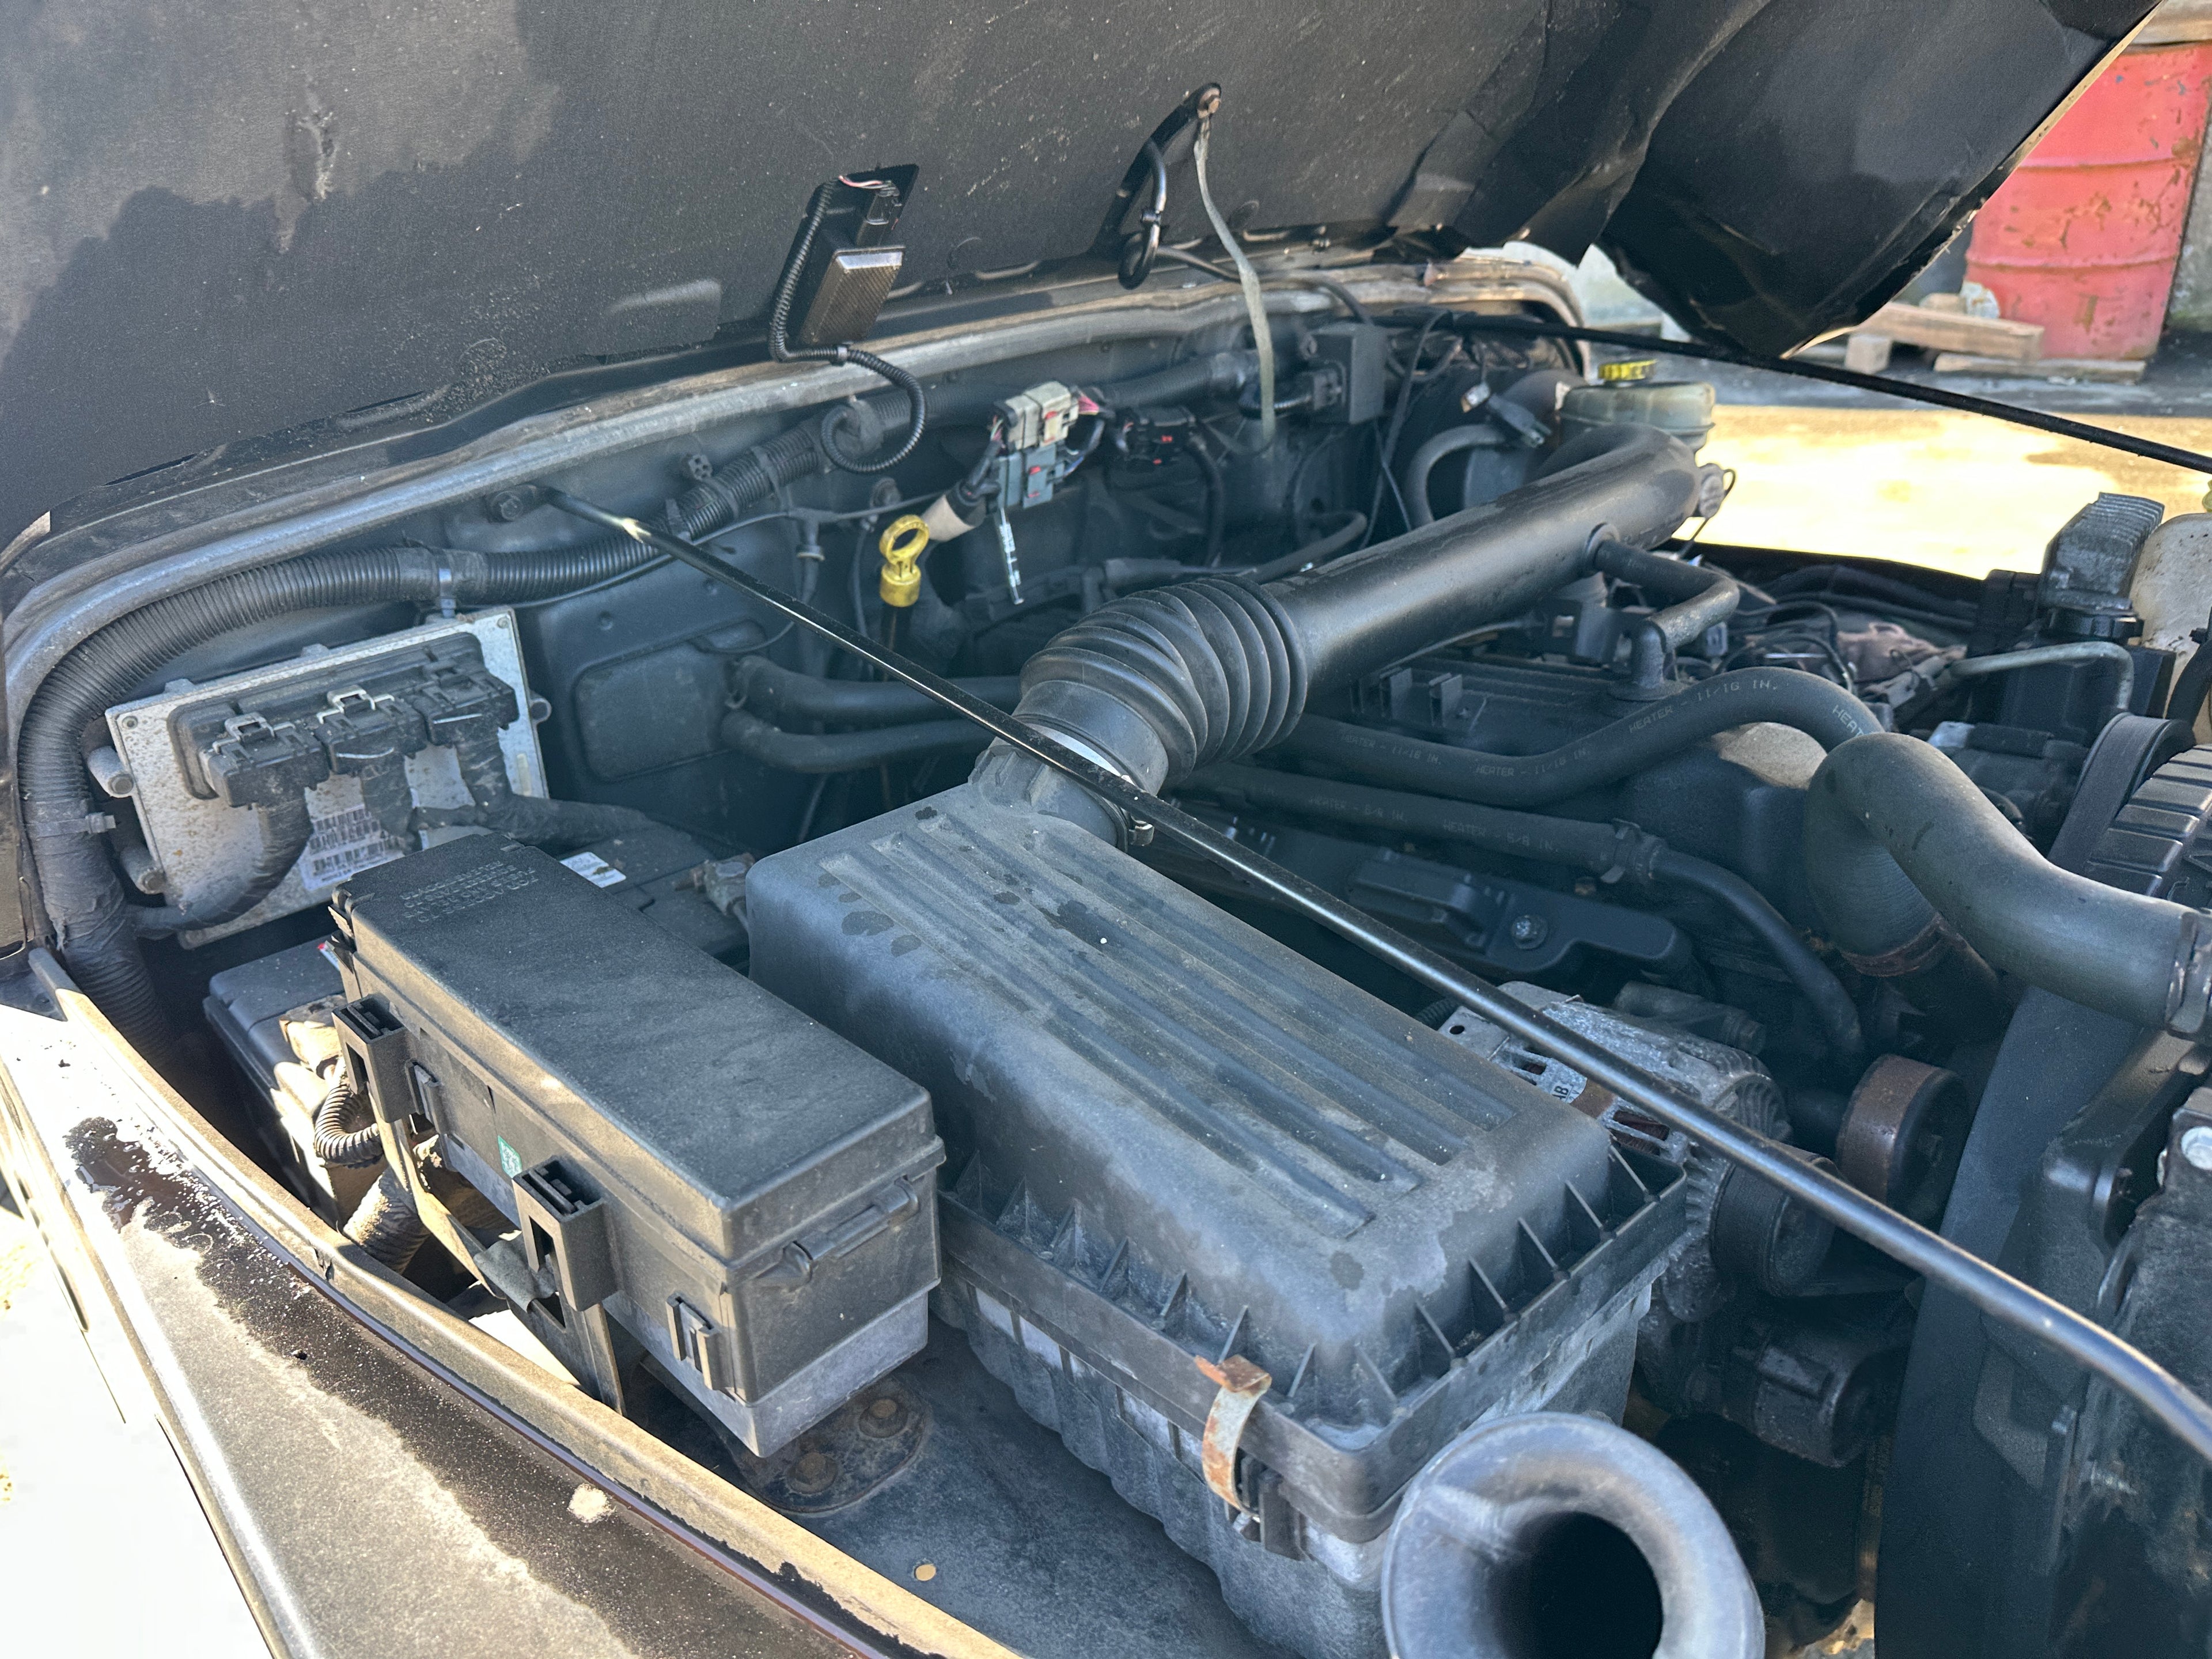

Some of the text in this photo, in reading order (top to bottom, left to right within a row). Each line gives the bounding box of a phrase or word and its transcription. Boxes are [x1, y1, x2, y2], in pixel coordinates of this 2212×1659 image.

[1628, 706, 1673, 734] HEATER
[1752, 679, 1778, 691] IN.
[1832, 704, 1865, 738] HEAT
[1475, 764, 1515, 777] HEATER
